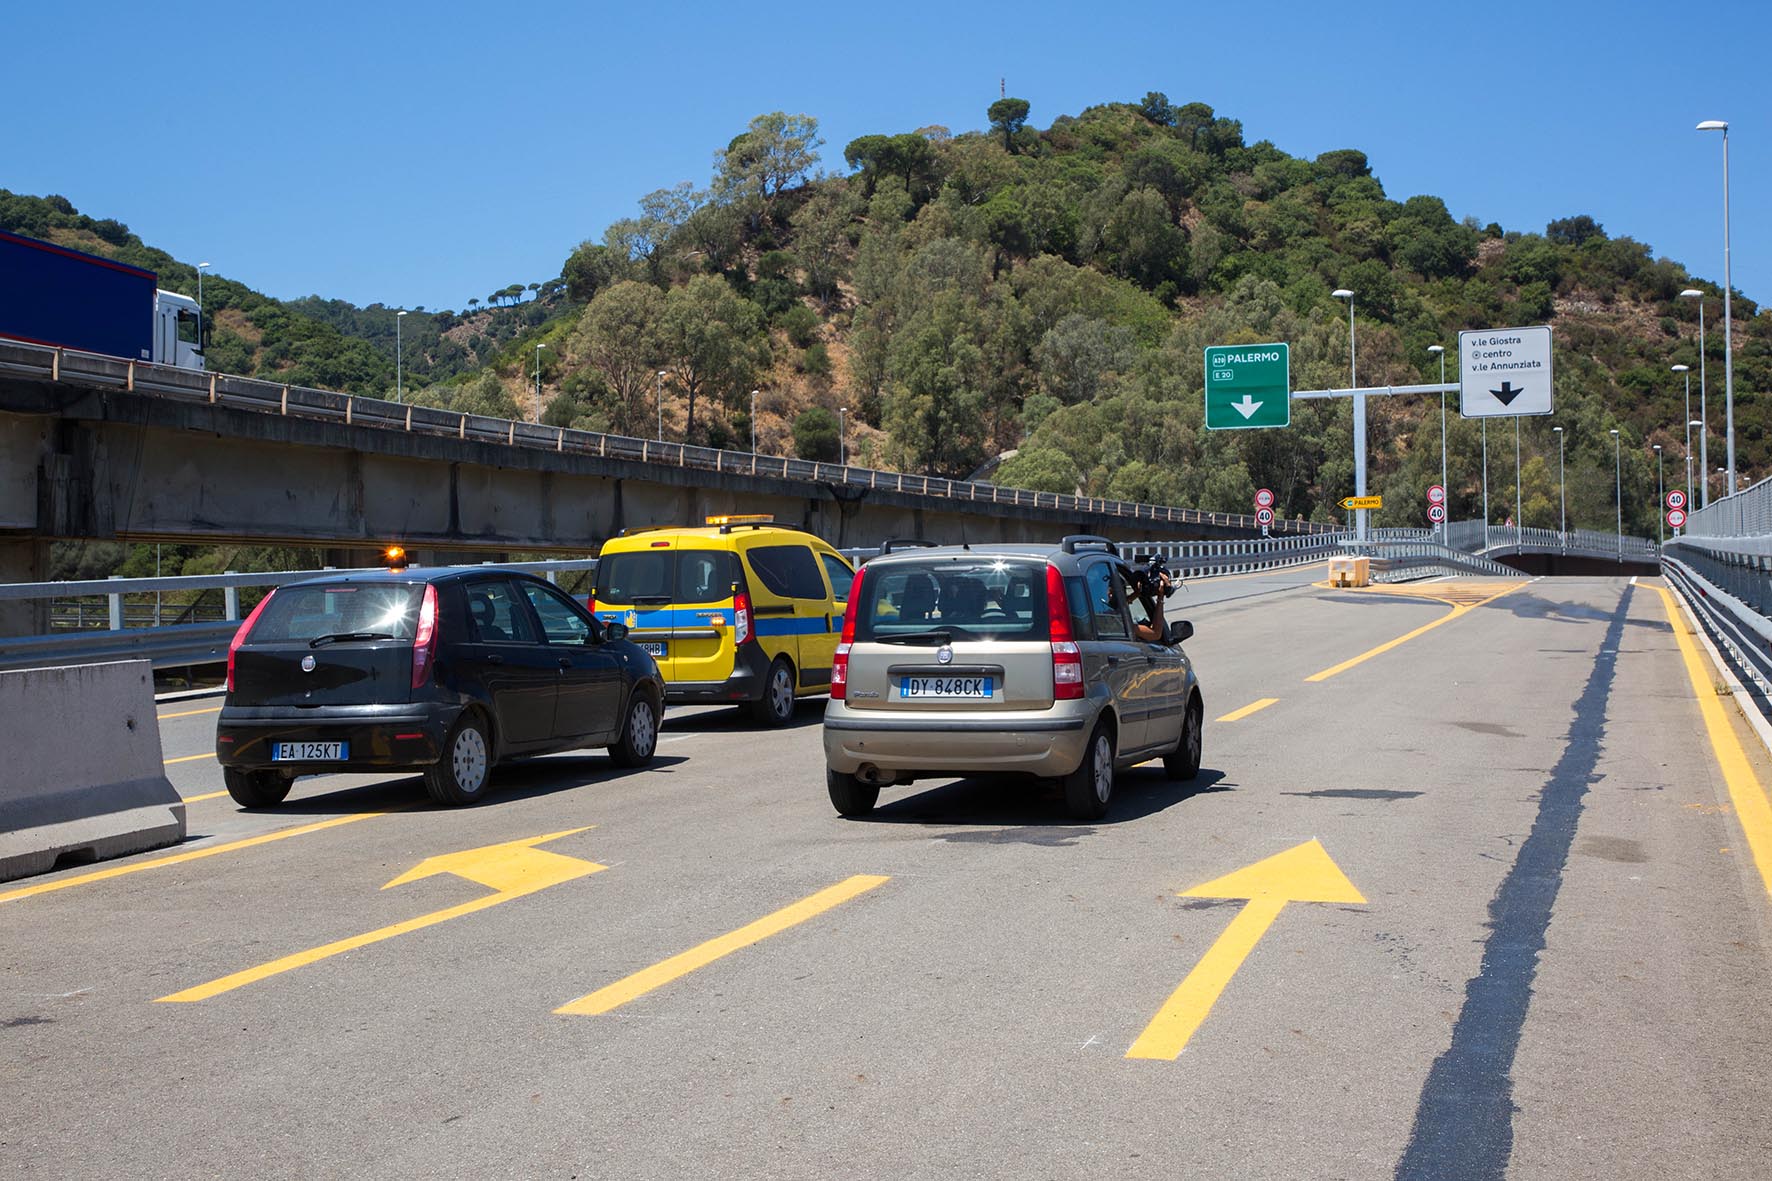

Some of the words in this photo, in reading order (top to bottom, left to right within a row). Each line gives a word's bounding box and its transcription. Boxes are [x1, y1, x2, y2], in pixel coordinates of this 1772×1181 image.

[1471, 338, 1487, 347] v.le
[1489, 337, 1522, 346] Giostra
[1227, 352, 1280, 364] PALERMO
[1482, 350, 1513, 359] centro
[1471, 363, 1488, 372] v.le
[1490, 360, 1542, 371] Annunziata
[1670, 495, 1682, 504] 40
[1259, 511, 1271, 521] 40
[1431, 509, 1443, 518] 40
[911, 679, 929, 695] DY
[935, 679, 982, 695] 848CK
[280, 743, 295, 759] EA
[301, 743, 340, 759] 125KT
